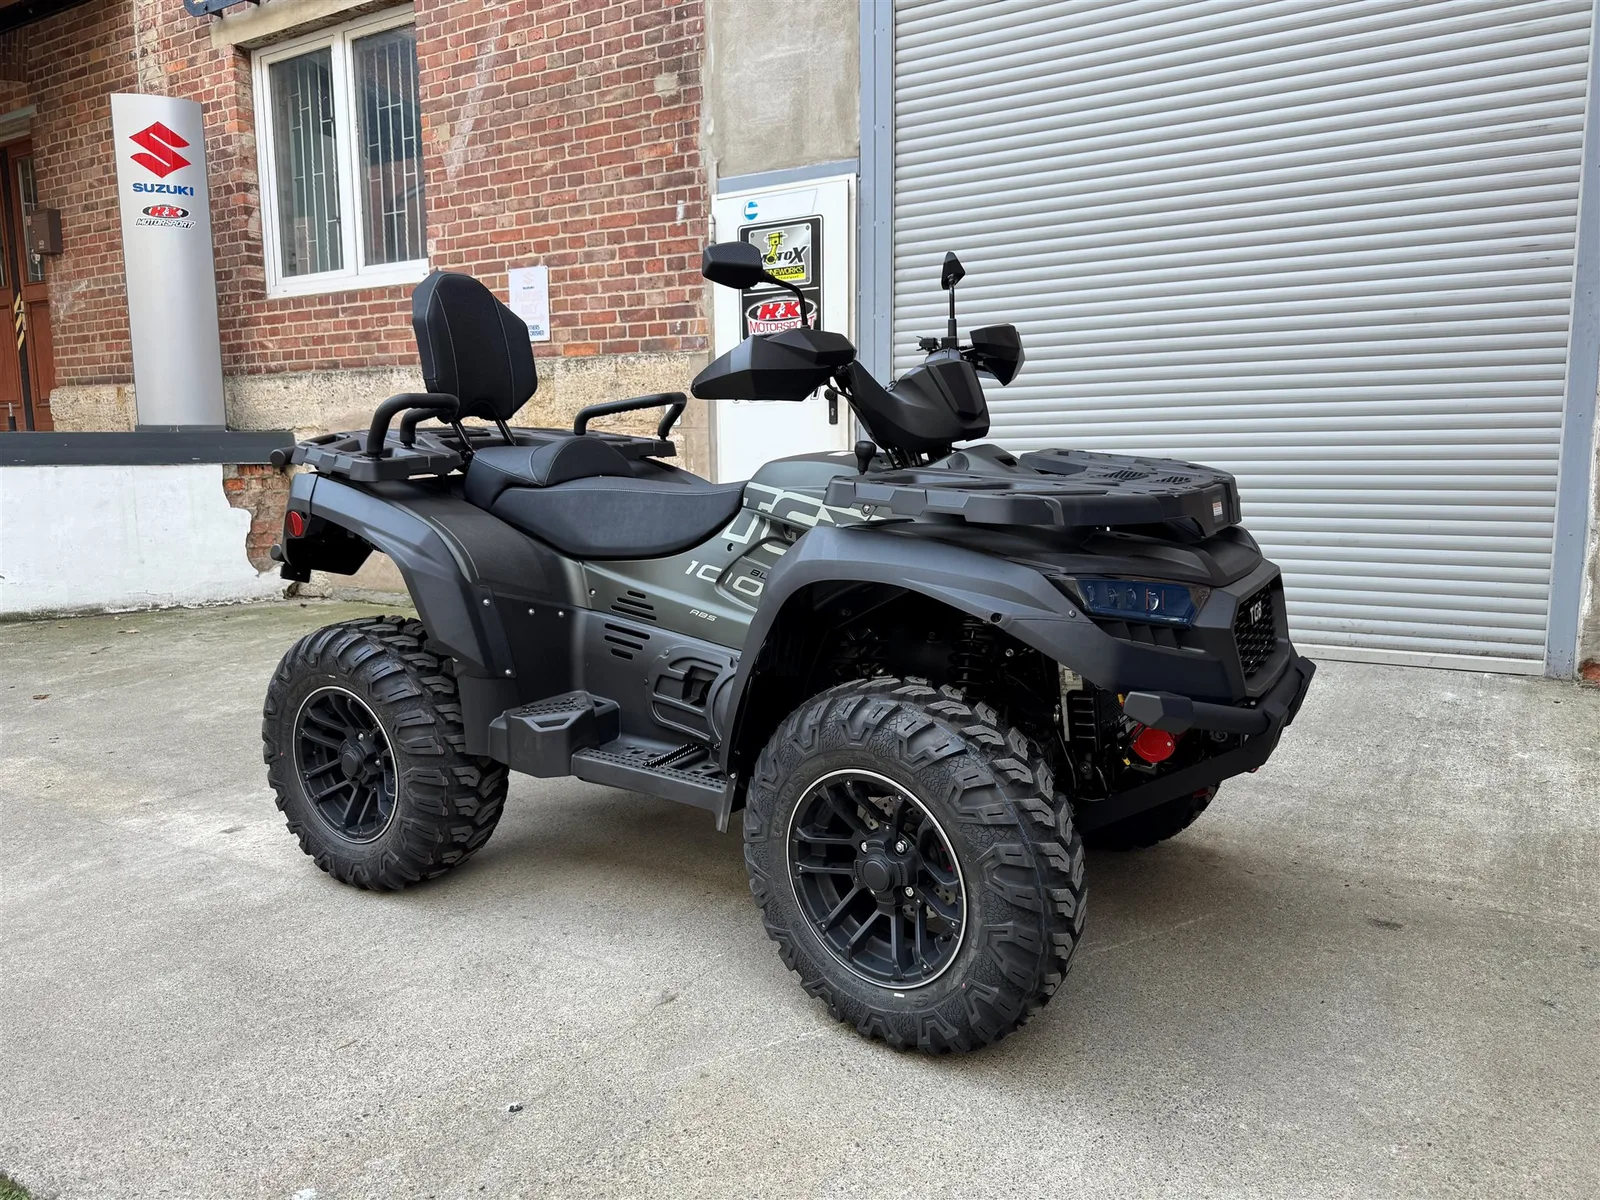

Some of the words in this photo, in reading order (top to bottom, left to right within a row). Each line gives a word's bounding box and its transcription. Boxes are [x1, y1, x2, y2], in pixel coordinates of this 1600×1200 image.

[132, 182, 195, 197] SUZUKI
[136, 218, 195, 229] MOTORSPORT
[749, 315, 815, 334] MOTORSPOT
[689, 609, 717, 622] ABS
